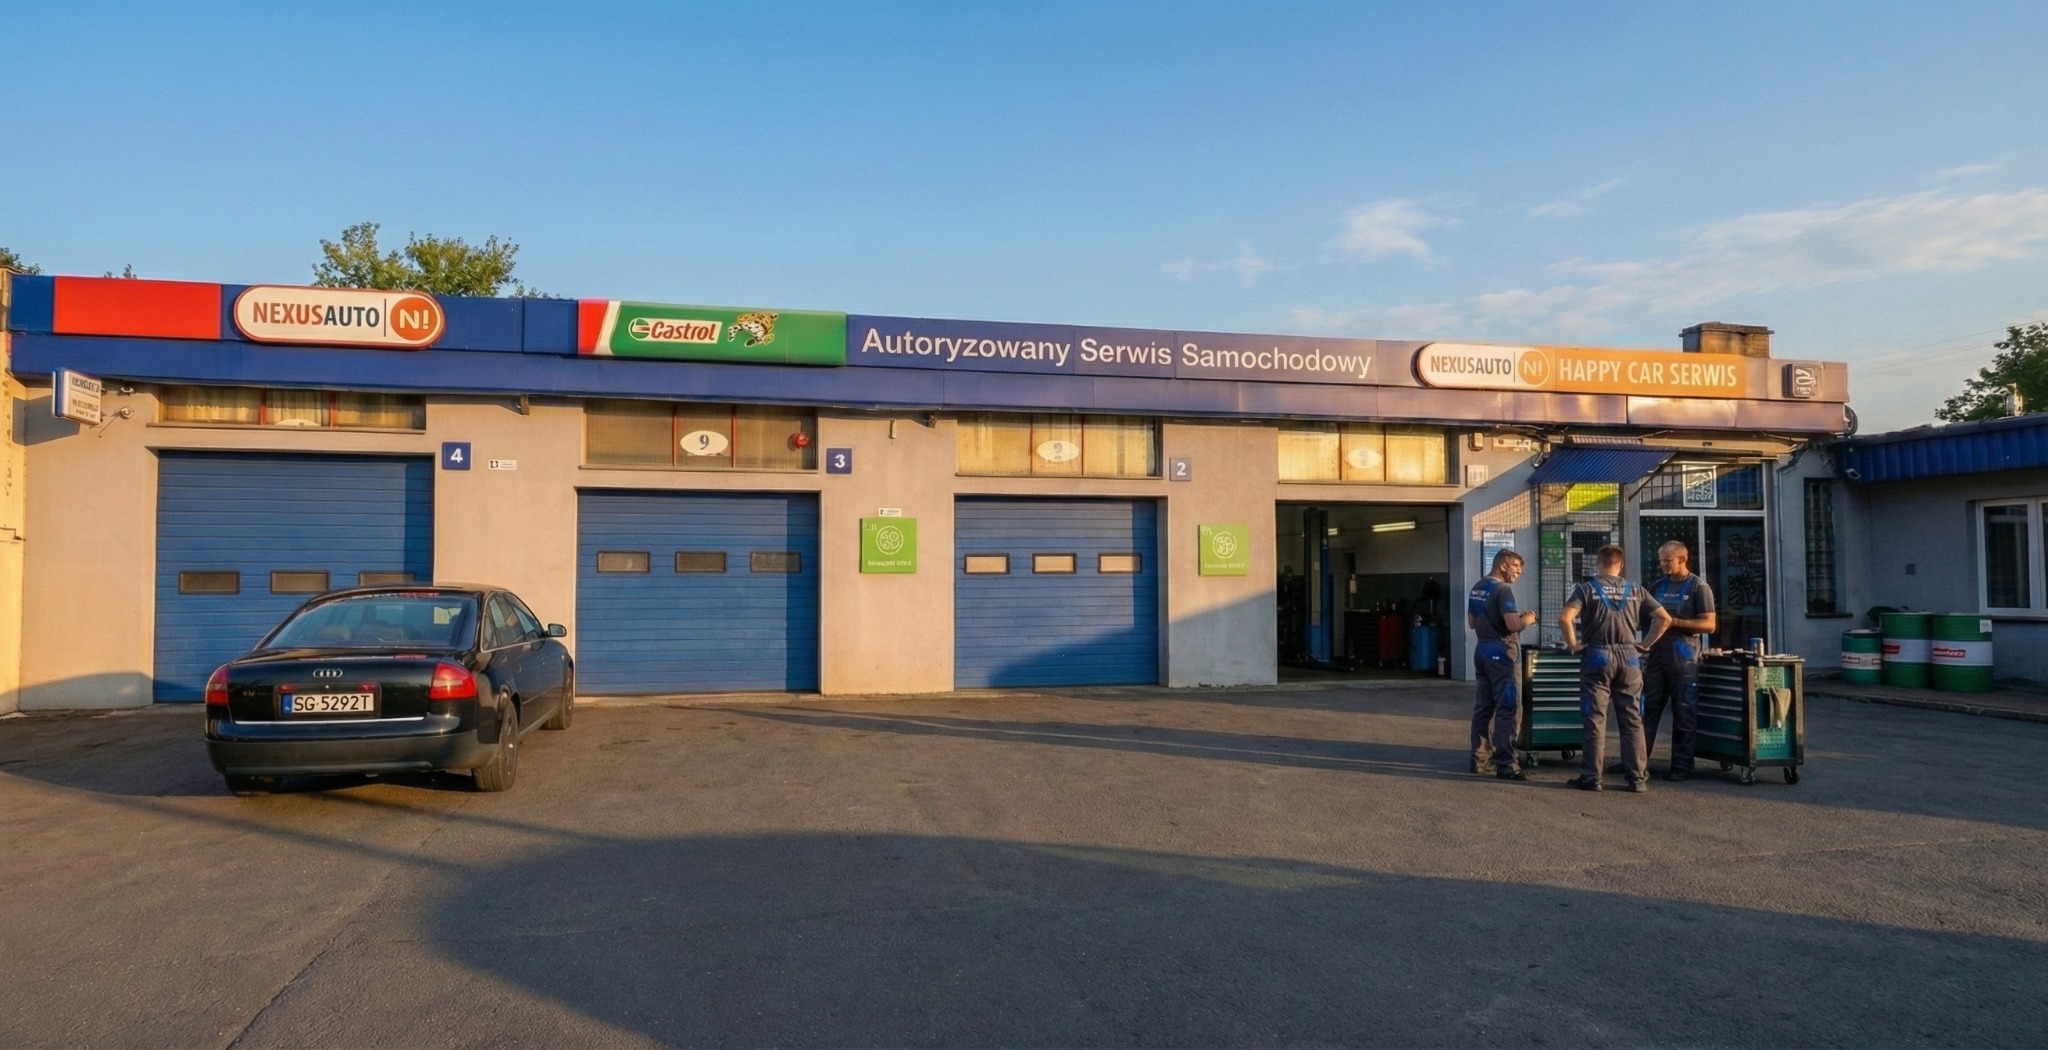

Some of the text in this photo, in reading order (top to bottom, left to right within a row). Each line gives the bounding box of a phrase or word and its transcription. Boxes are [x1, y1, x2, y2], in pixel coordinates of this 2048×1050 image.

[252, 301, 430, 330] NEXUSAUTO N!
[650, 321, 716, 341] Castrol
[861, 327, 1372, 379] Autoryzowany Serwis Samochodowy
[1430, 354, 1543, 377] NEXUSAUTO N!
[1559, 358, 1737, 387] HAPPY CAR SERWIS
[450, 447, 464, 464] 4
[834, 453, 846, 469] 3
[1176, 461, 1187, 476] 2
[294, 694, 371, 711] SG 5292T
